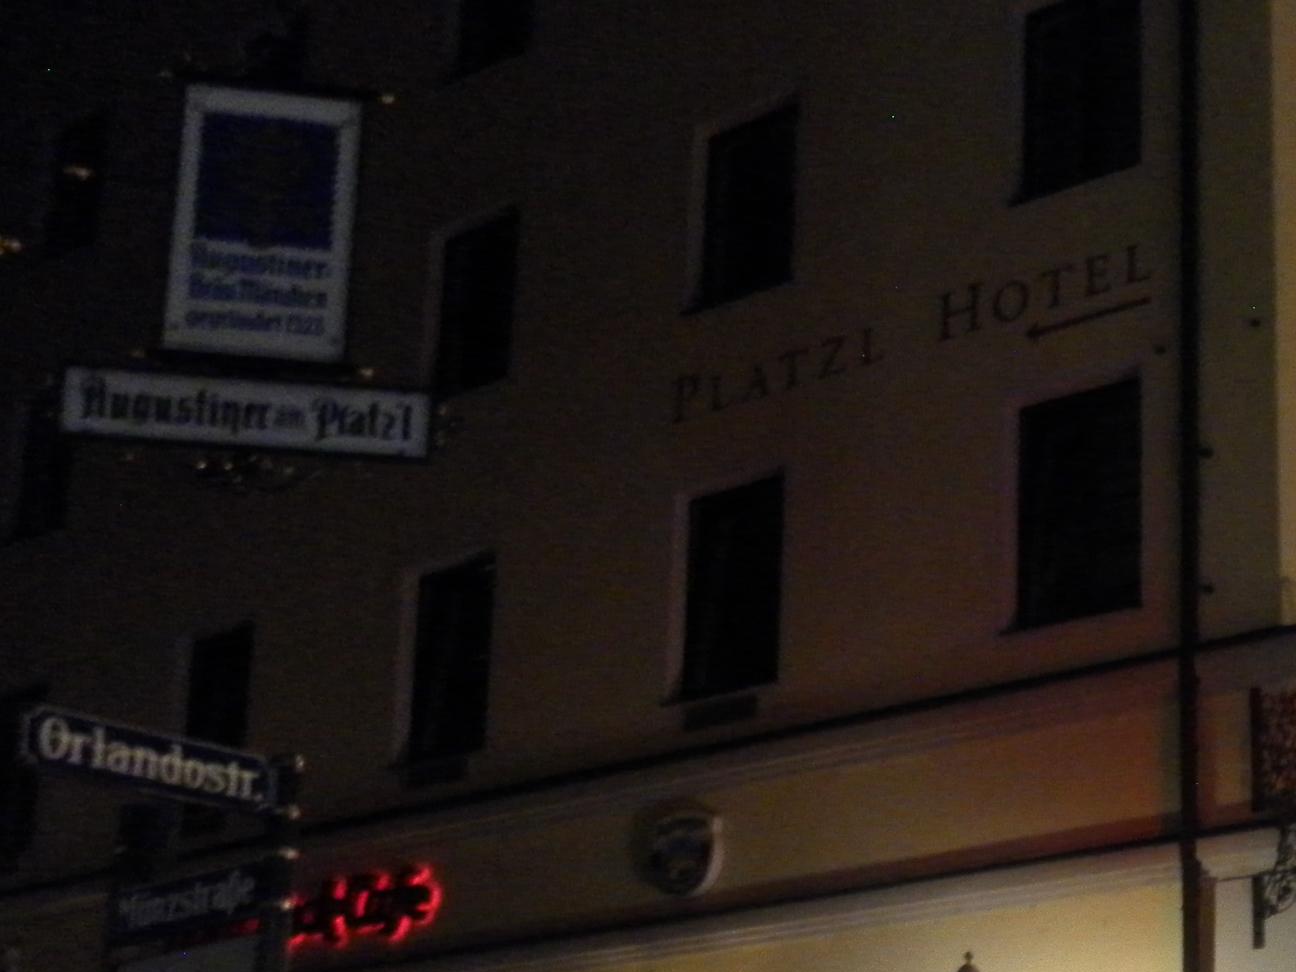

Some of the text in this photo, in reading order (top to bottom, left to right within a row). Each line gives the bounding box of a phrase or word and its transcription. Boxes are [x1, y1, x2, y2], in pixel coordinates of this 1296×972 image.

[671, 243, 1152, 424] PLATZL HOTEL
[80, 376, 271, 436] Augustiner
[315, 397, 413, 442] Platzl
[38, 717, 263, 803] Orlandostr.
